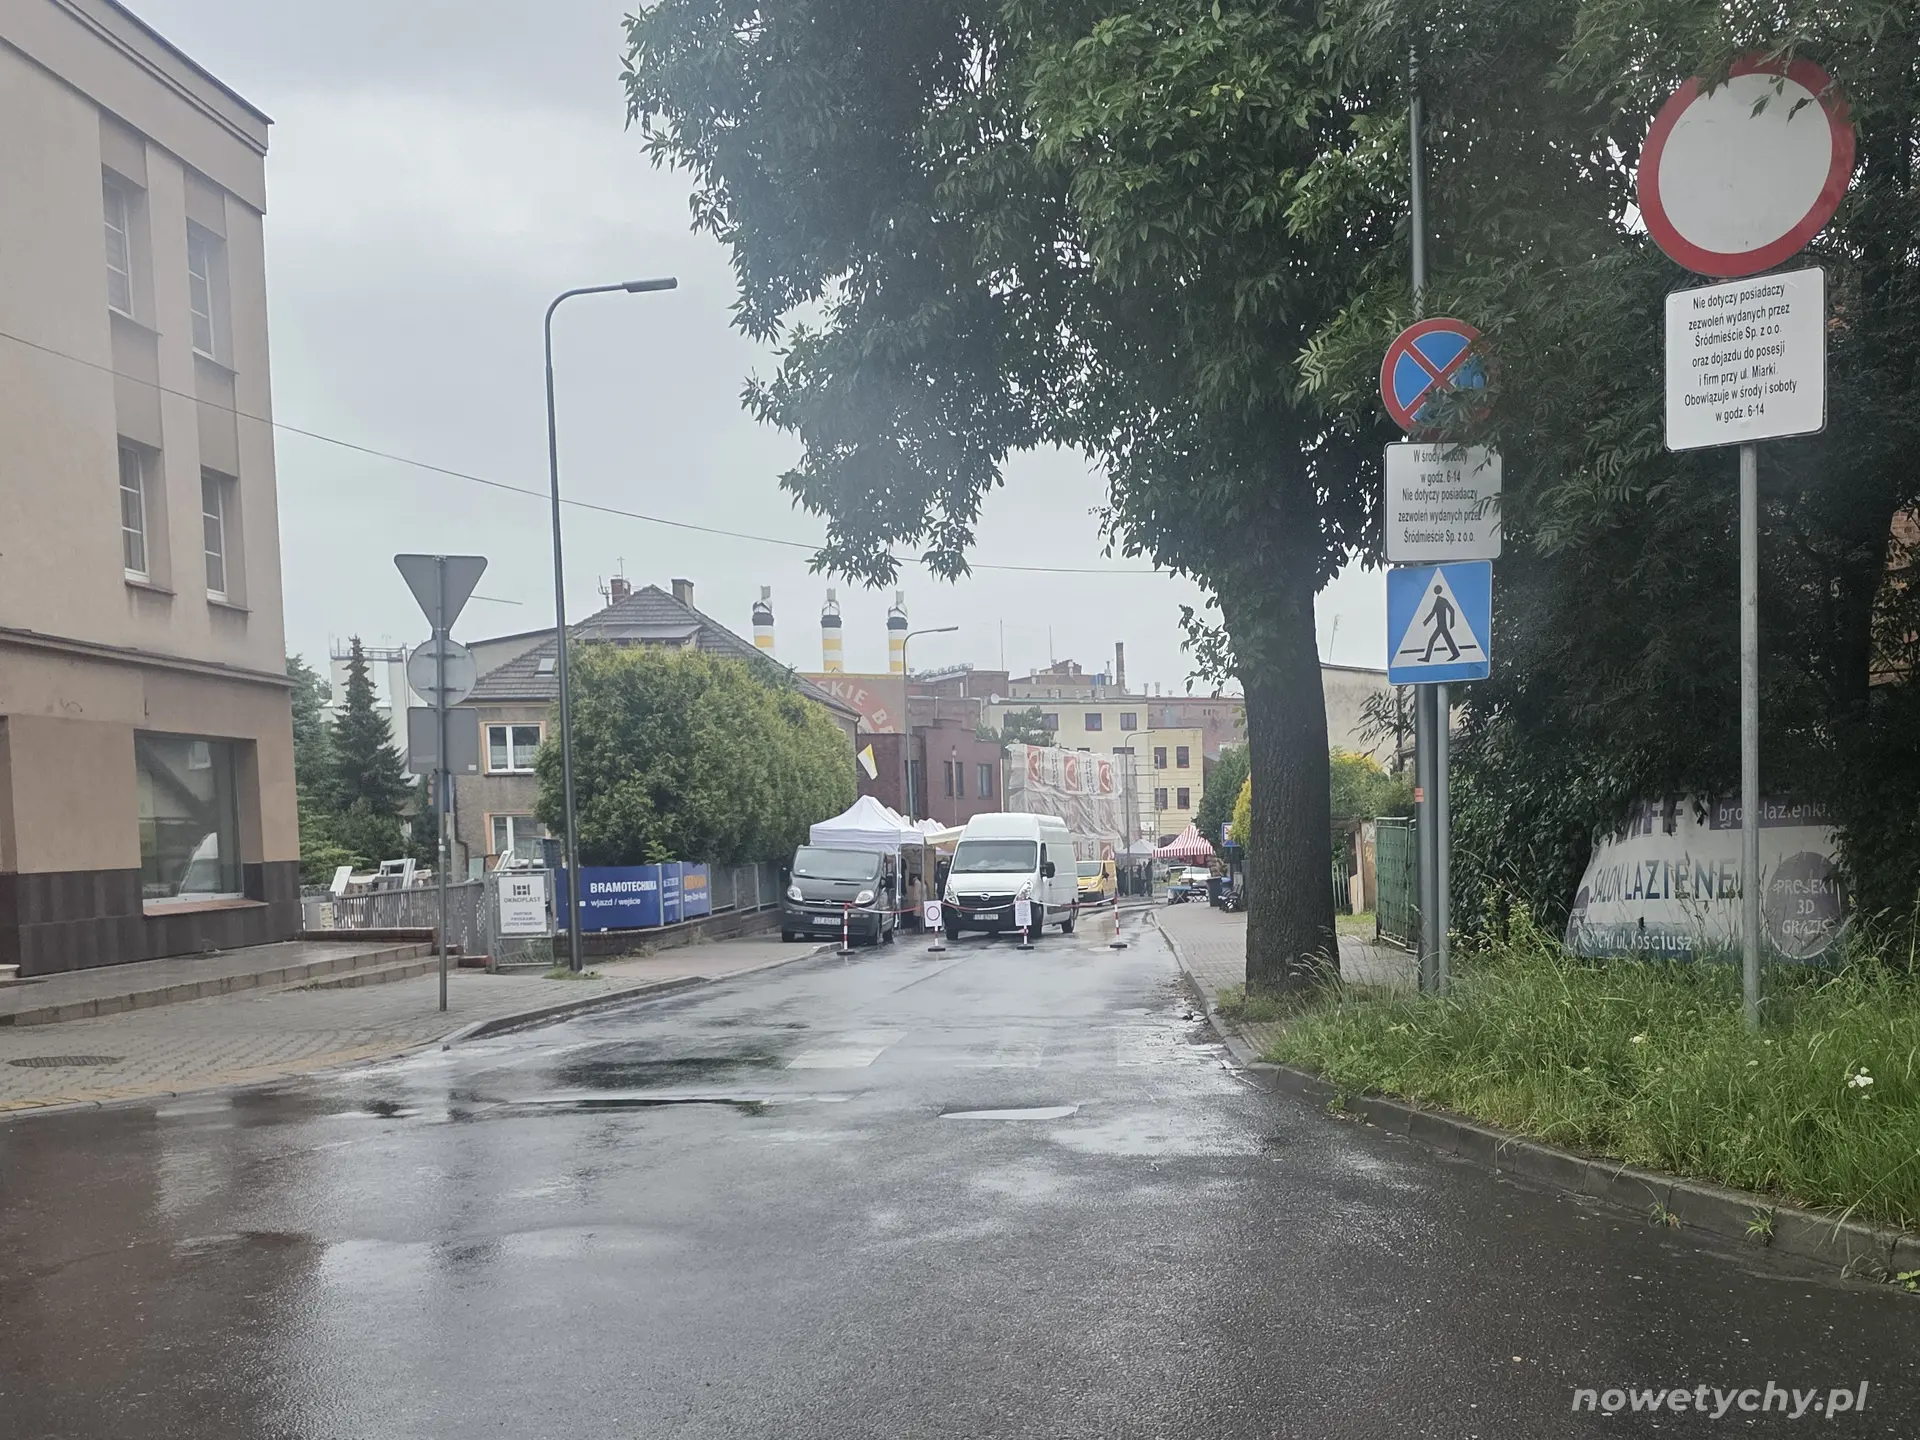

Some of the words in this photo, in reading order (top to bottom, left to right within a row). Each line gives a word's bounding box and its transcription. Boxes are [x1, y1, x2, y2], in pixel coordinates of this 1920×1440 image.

[1693, 297, 1705, 310] Nie
[1708, 294, 1738, 308] dotyczy
[1740, 284, 1785, 302] posiadaczy
[1689, 314, 1724, 330] zezwoleń
[1726, 306, 1766, 326] wydanych
[1768, 304, 1790, 319] przez
[1695, 328, 1743, 347] Śródmieście
[1745, 326, 1758, 340] Sp.
[1760, 327, 1765, 336] z
[1692, 355, 1709, 367] oraz
[1711, 349, 1742, 367] dojazdu
[1744, 345, 1754, 359] do
[1757, 341, 1785, 360] posesji
[1699, 375, 1702, 386] i
[1704, 373, 1719, 386] firm
[1721, 371, 1738, 386] przy
[1740, 367, 1749, 380] ul.
[1685, 390, 1729, 406] Obowiązuje
[1731, 391, 1738, 399] w
[1740, 385, 1762, 399] środy
[1765, 382, 1767, 394] i
[1769, 379, 1797, 395] soboty
[1715, 410, 1722, 421] w
[1724, 406, 1745, 424] godz.
[1747, 402, 1764, 417] 6-14
[1413, 450, 1420, 462] W
[1422, 450, 1440, 465] środy
[1420, 474, 1426, 483] w
[1427, 470, 1446, 486] godz.
[1447, 470, 1460, 483] 6-14
[1402, 488, 1412, 501] Nie
[1415, 489, 1440, 504] dotyczy
[1441, 487, 1478, 504] posiadaczy
[1398, 509, 1428, 522] zezwoleń
[1430, 509, 1462, 524] wydanych
[1464, 511, 1481, 524] przez
[1404, 528, 1444, 543] Śródmieście
[1446, 529, 1456, 545] Sp.
[1458, 533, 1461, 542] z
[1624, 858, 1744, 901] LAZIENE
